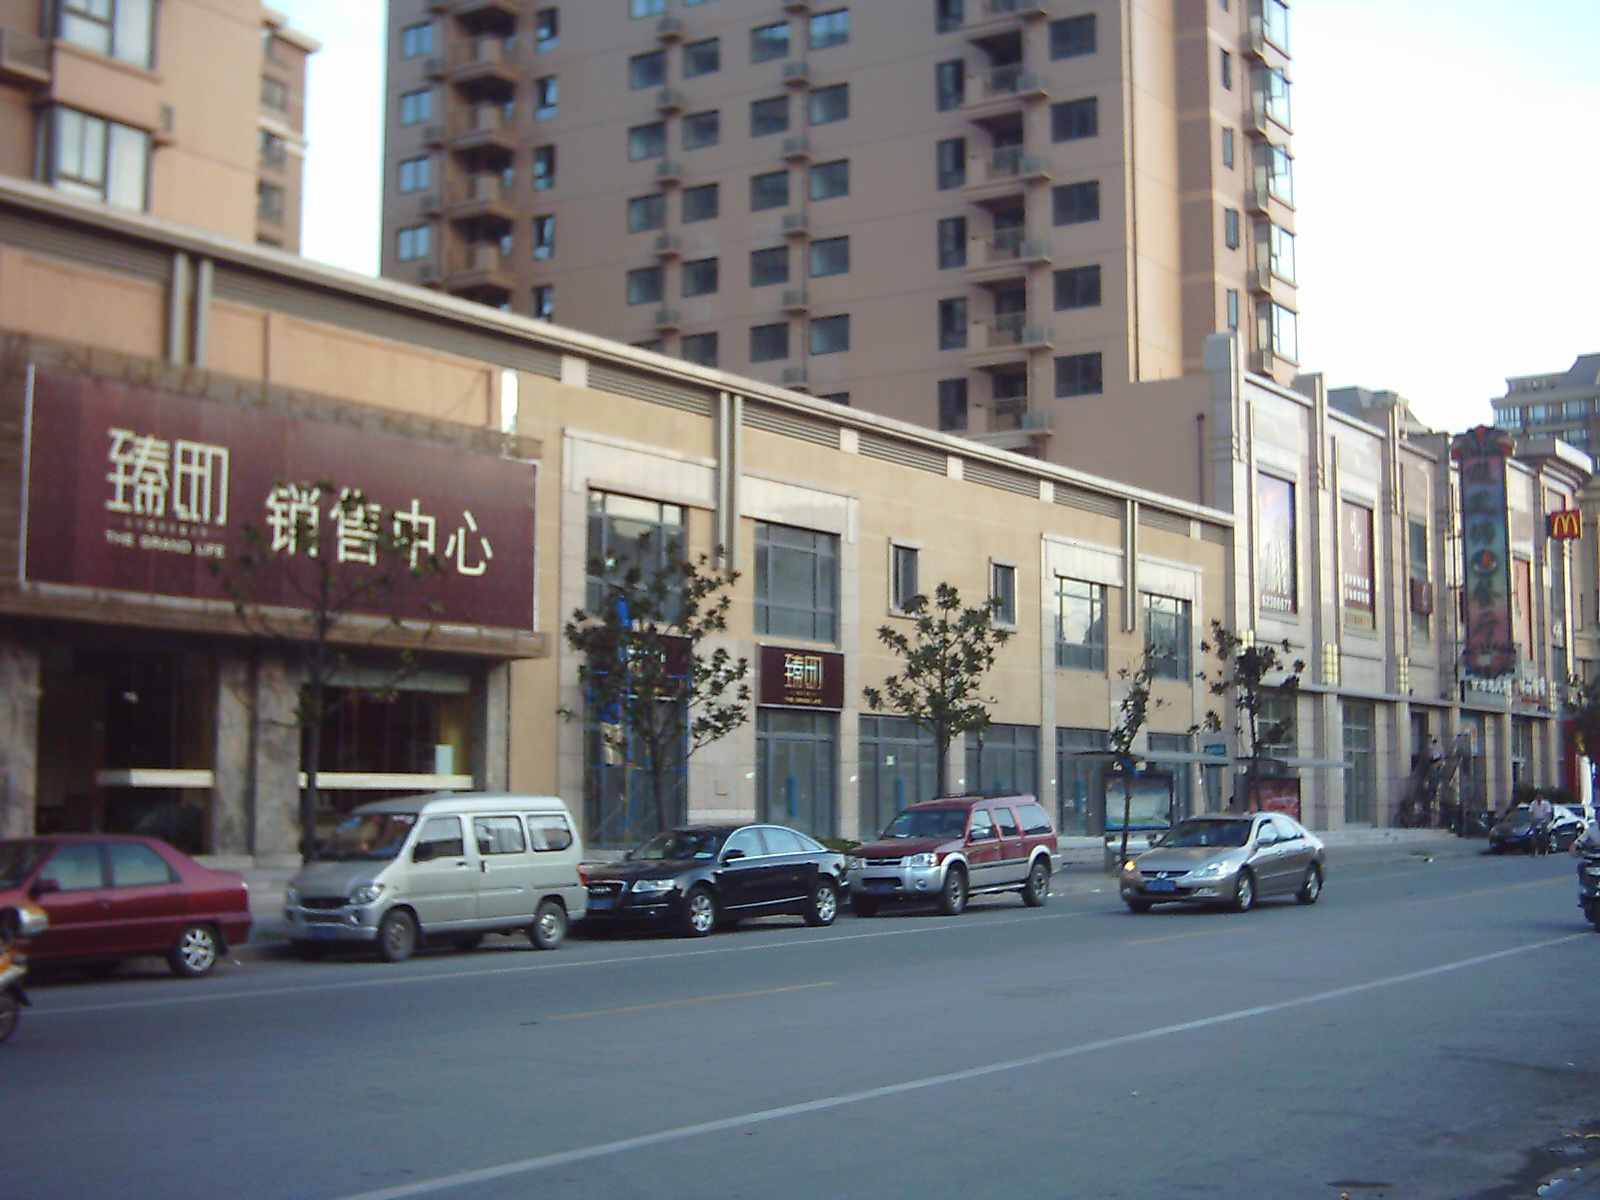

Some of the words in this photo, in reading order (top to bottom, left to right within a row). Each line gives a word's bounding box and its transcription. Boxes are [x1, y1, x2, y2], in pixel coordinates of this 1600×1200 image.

[105, 529, 135, 548] THE
[264, 483, 494, 577] 销售中心
